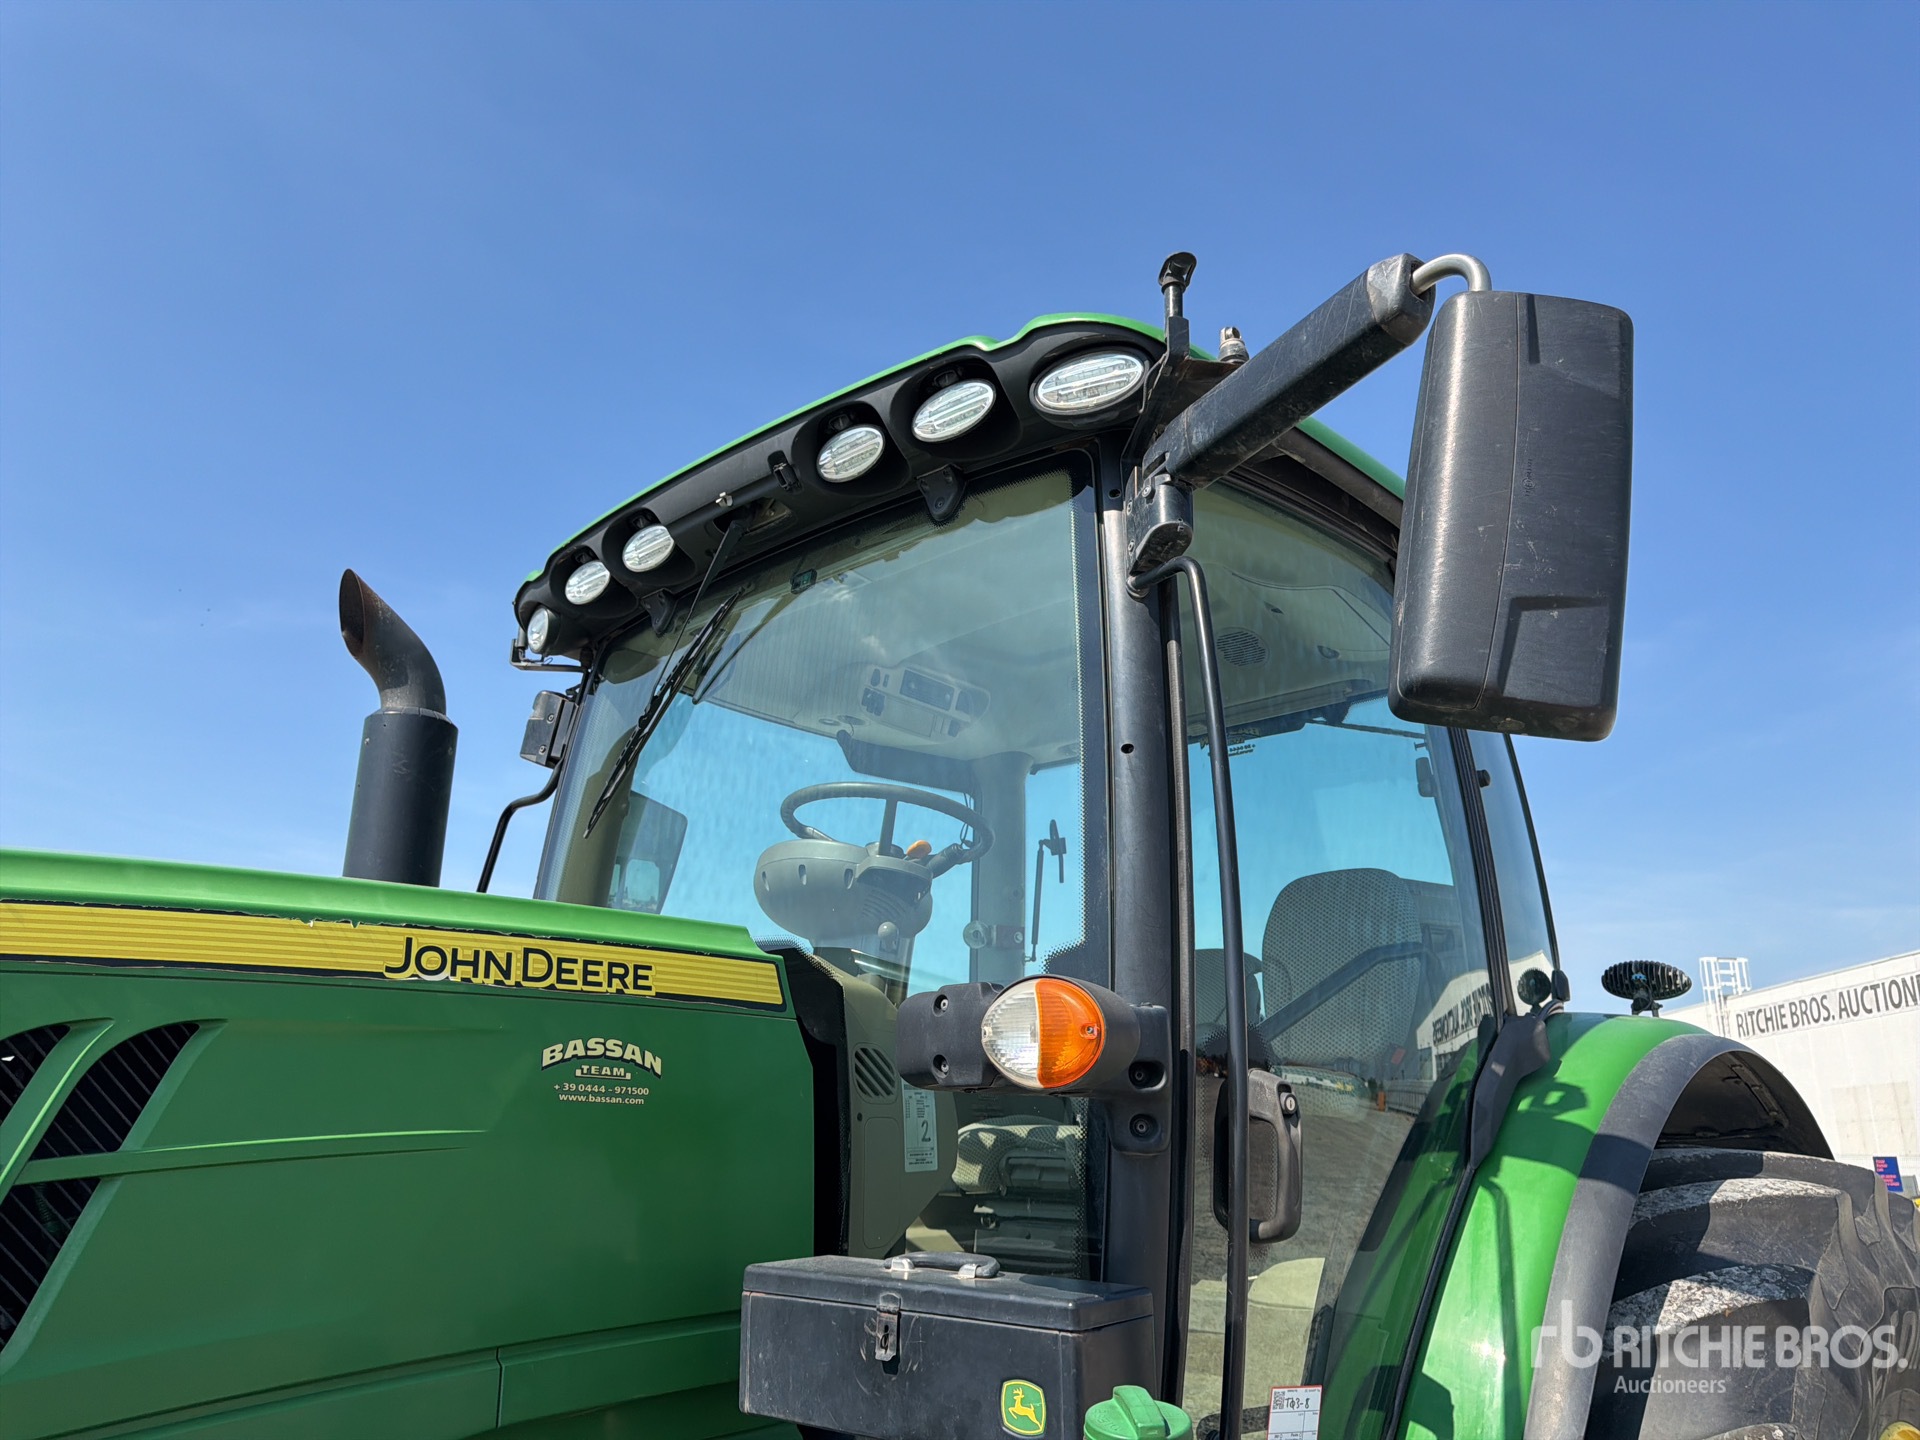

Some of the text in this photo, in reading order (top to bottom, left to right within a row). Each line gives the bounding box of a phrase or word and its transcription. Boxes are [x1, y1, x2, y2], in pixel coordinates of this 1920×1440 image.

[384, 936, 655, 993] JOHN DEERE
[1735, 1003, 1788, 1038] RITCHIE
[1788, 994, 1836, 1028] BROS.
[541, 1037, 662, 1080] BASSAN
[581, 1064, 626, 1077] TEAM
[558, 1092, 645, 1104] www.bassan.com
[562, 1082, 577, 1092] 39
[578, 1083, 606, 1094] 0444
[614, 1085, 650, 1096] 971500
